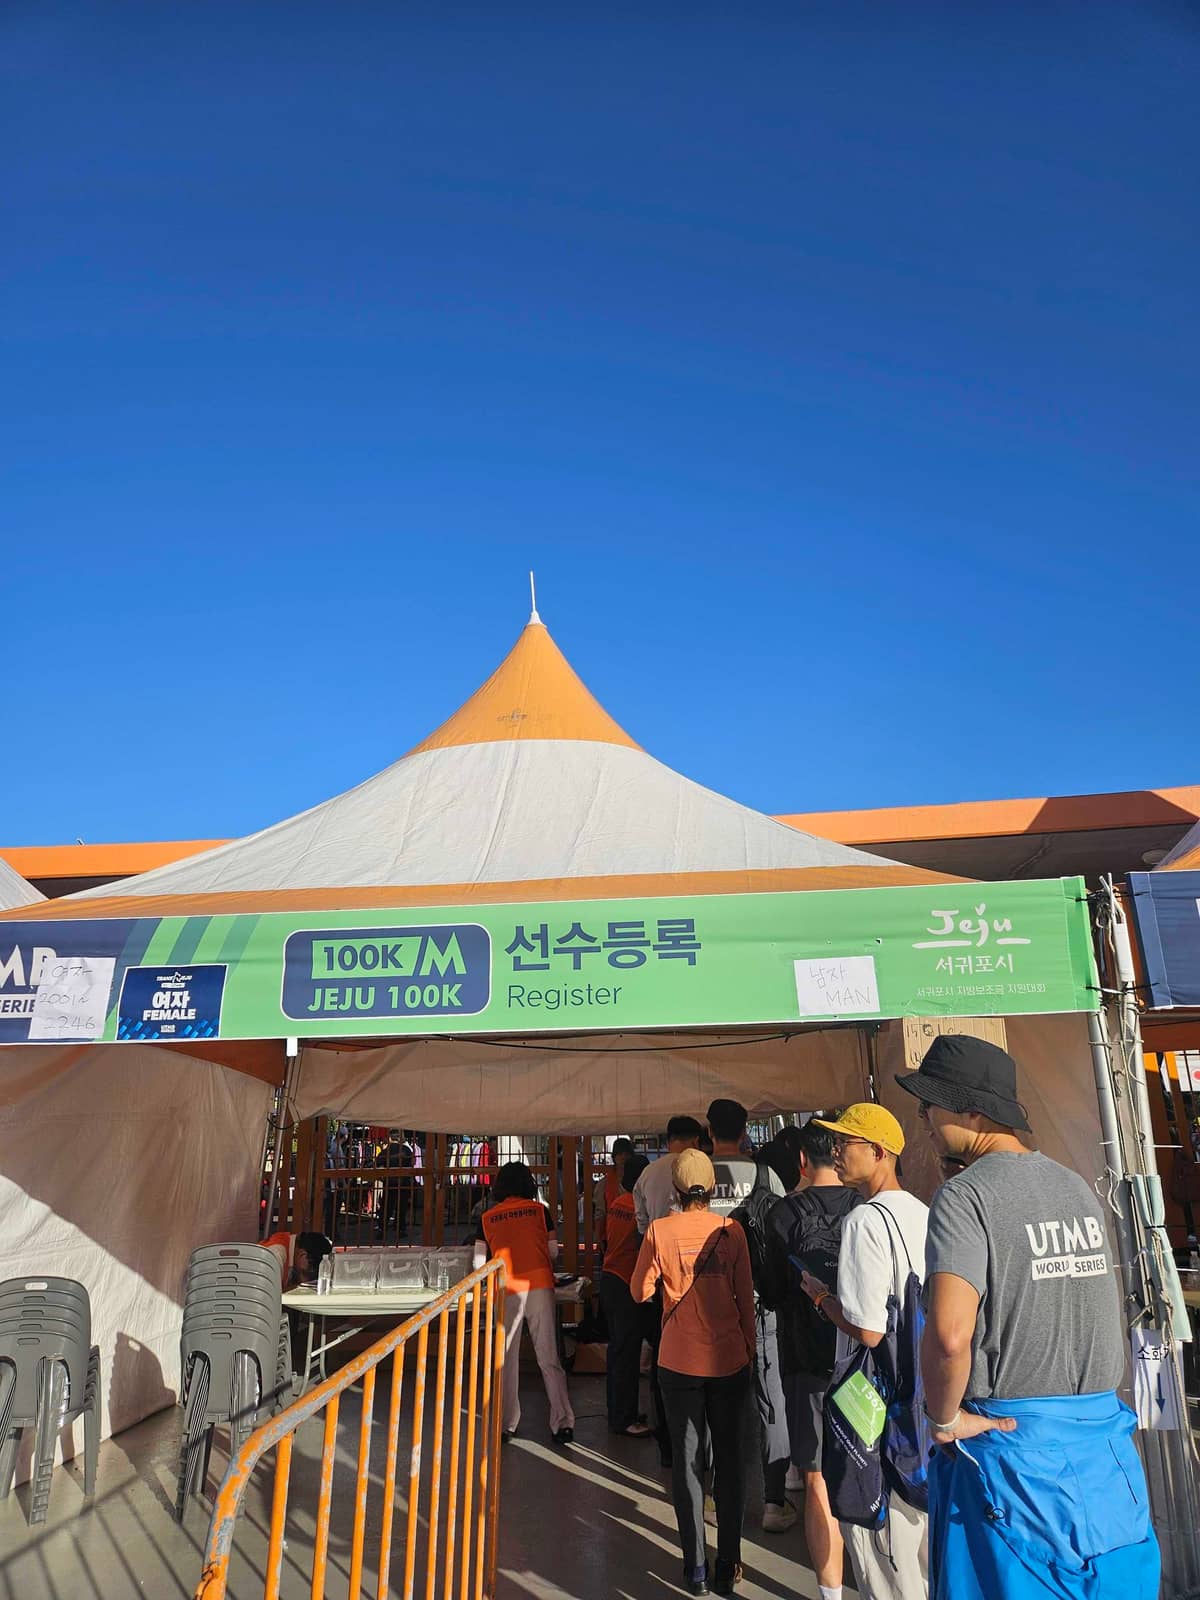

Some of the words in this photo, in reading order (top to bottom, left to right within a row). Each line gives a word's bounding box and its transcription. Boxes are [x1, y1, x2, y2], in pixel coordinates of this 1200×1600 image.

[926, 902, 1012, 947] Jeju
[323, 943, 404, 971] 100K
[505, 918, 702, 972] 선수등록
[936, 953, 1014, 975] 서귀포시
[152, 990, 191, 1010] 여자
[307, 986, 375, 1012] JEJU
[387, 983, 462, 1009] 100K
[508, 983, 622, 1010] Register
[826, 986, 871, 1007] MAN
[142, 1009, 197, 1021] FEMALE
[1025, 1216, 1104, 1257] UTMB
[1074, 1258, 1105, 1273] SERIES
[861, 1383, 884, 1412] 1567
